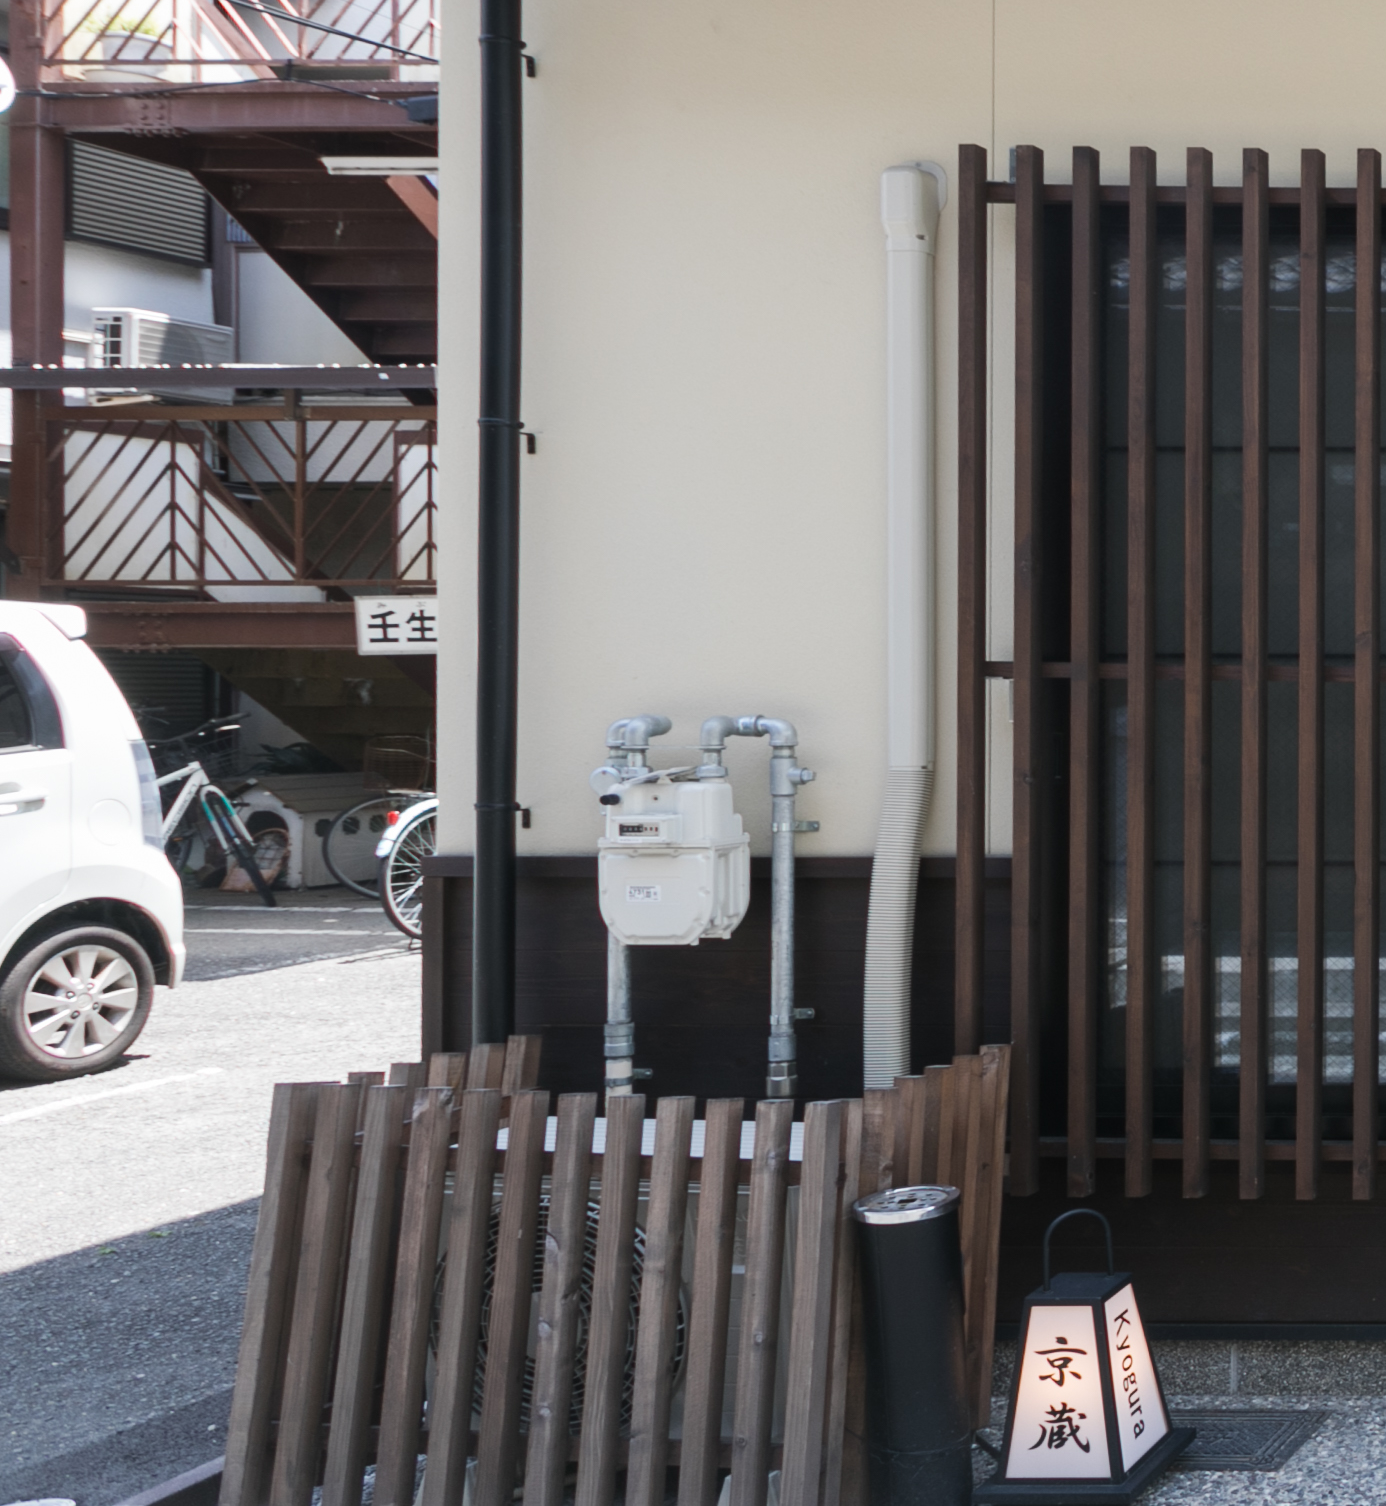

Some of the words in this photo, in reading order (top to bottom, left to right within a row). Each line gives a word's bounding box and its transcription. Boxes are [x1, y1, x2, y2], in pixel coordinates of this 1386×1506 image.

[367, 609, 437, 643] 壬生
[1027, 1336, 1091, 1453] 京蔵
[1113, 1308, 1146, 1440] Kyogura
